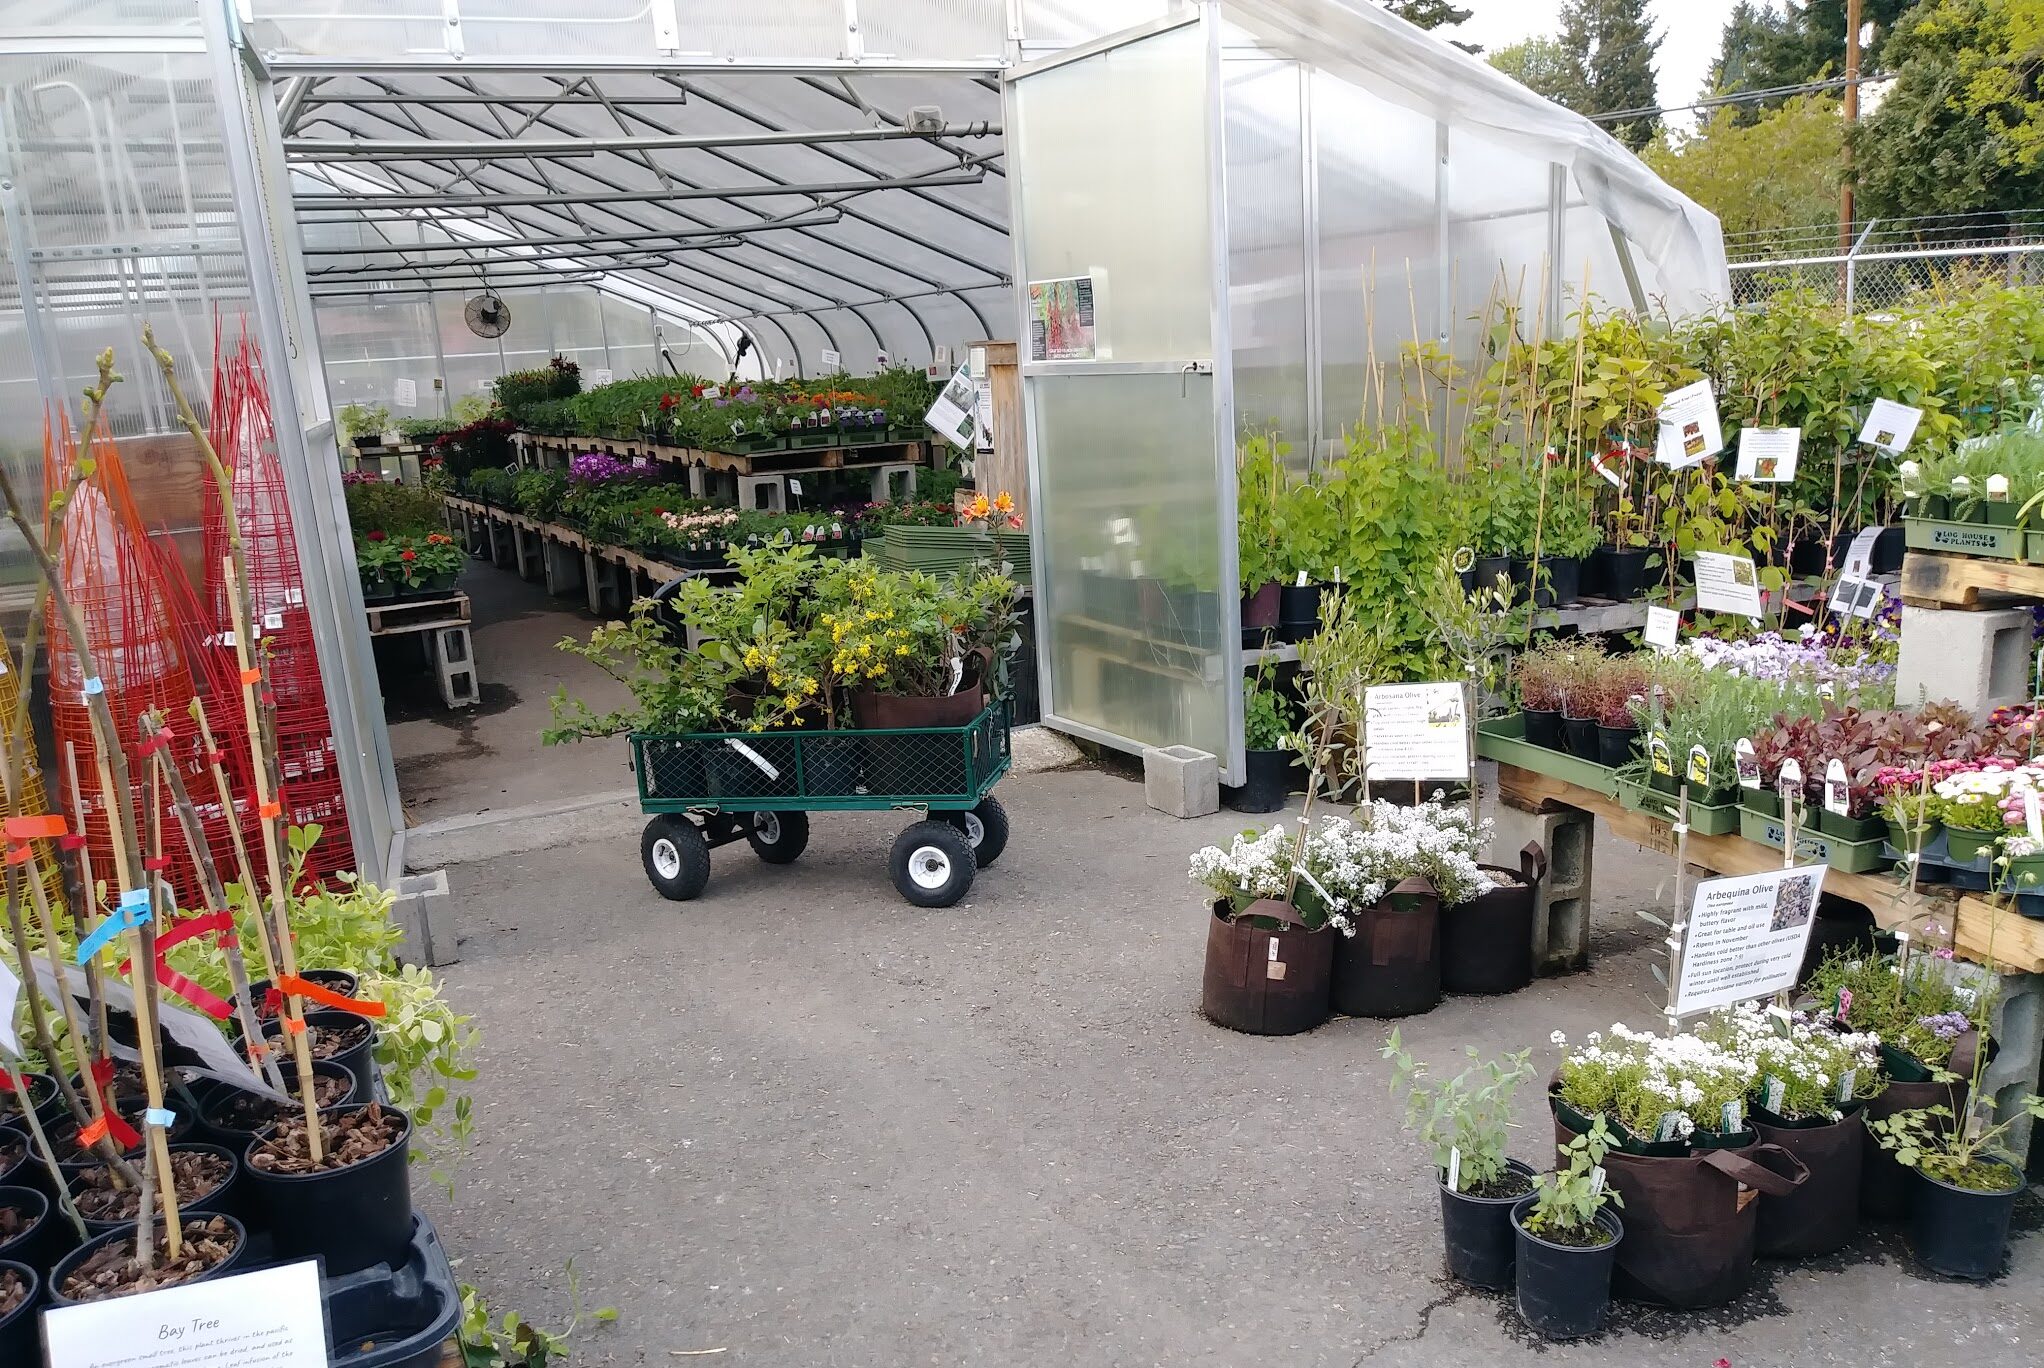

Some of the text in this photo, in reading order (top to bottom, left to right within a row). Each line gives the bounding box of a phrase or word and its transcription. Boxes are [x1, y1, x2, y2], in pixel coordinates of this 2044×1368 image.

[1943, 530, 1989, 541] LOG HOUSE
[1950, 539, 1981, 547] PLANTS
[1706, 884, 1774, 902] Arbequina Olive
[1701, 910, 1719, 919] Highly
[1720, 906, 1742, 916] fragrant
[1699, 918, 1720, 928] buttery
[1722, 935, 1749, 945] November
[158, 1318, 220, 1340] Bay Tree
